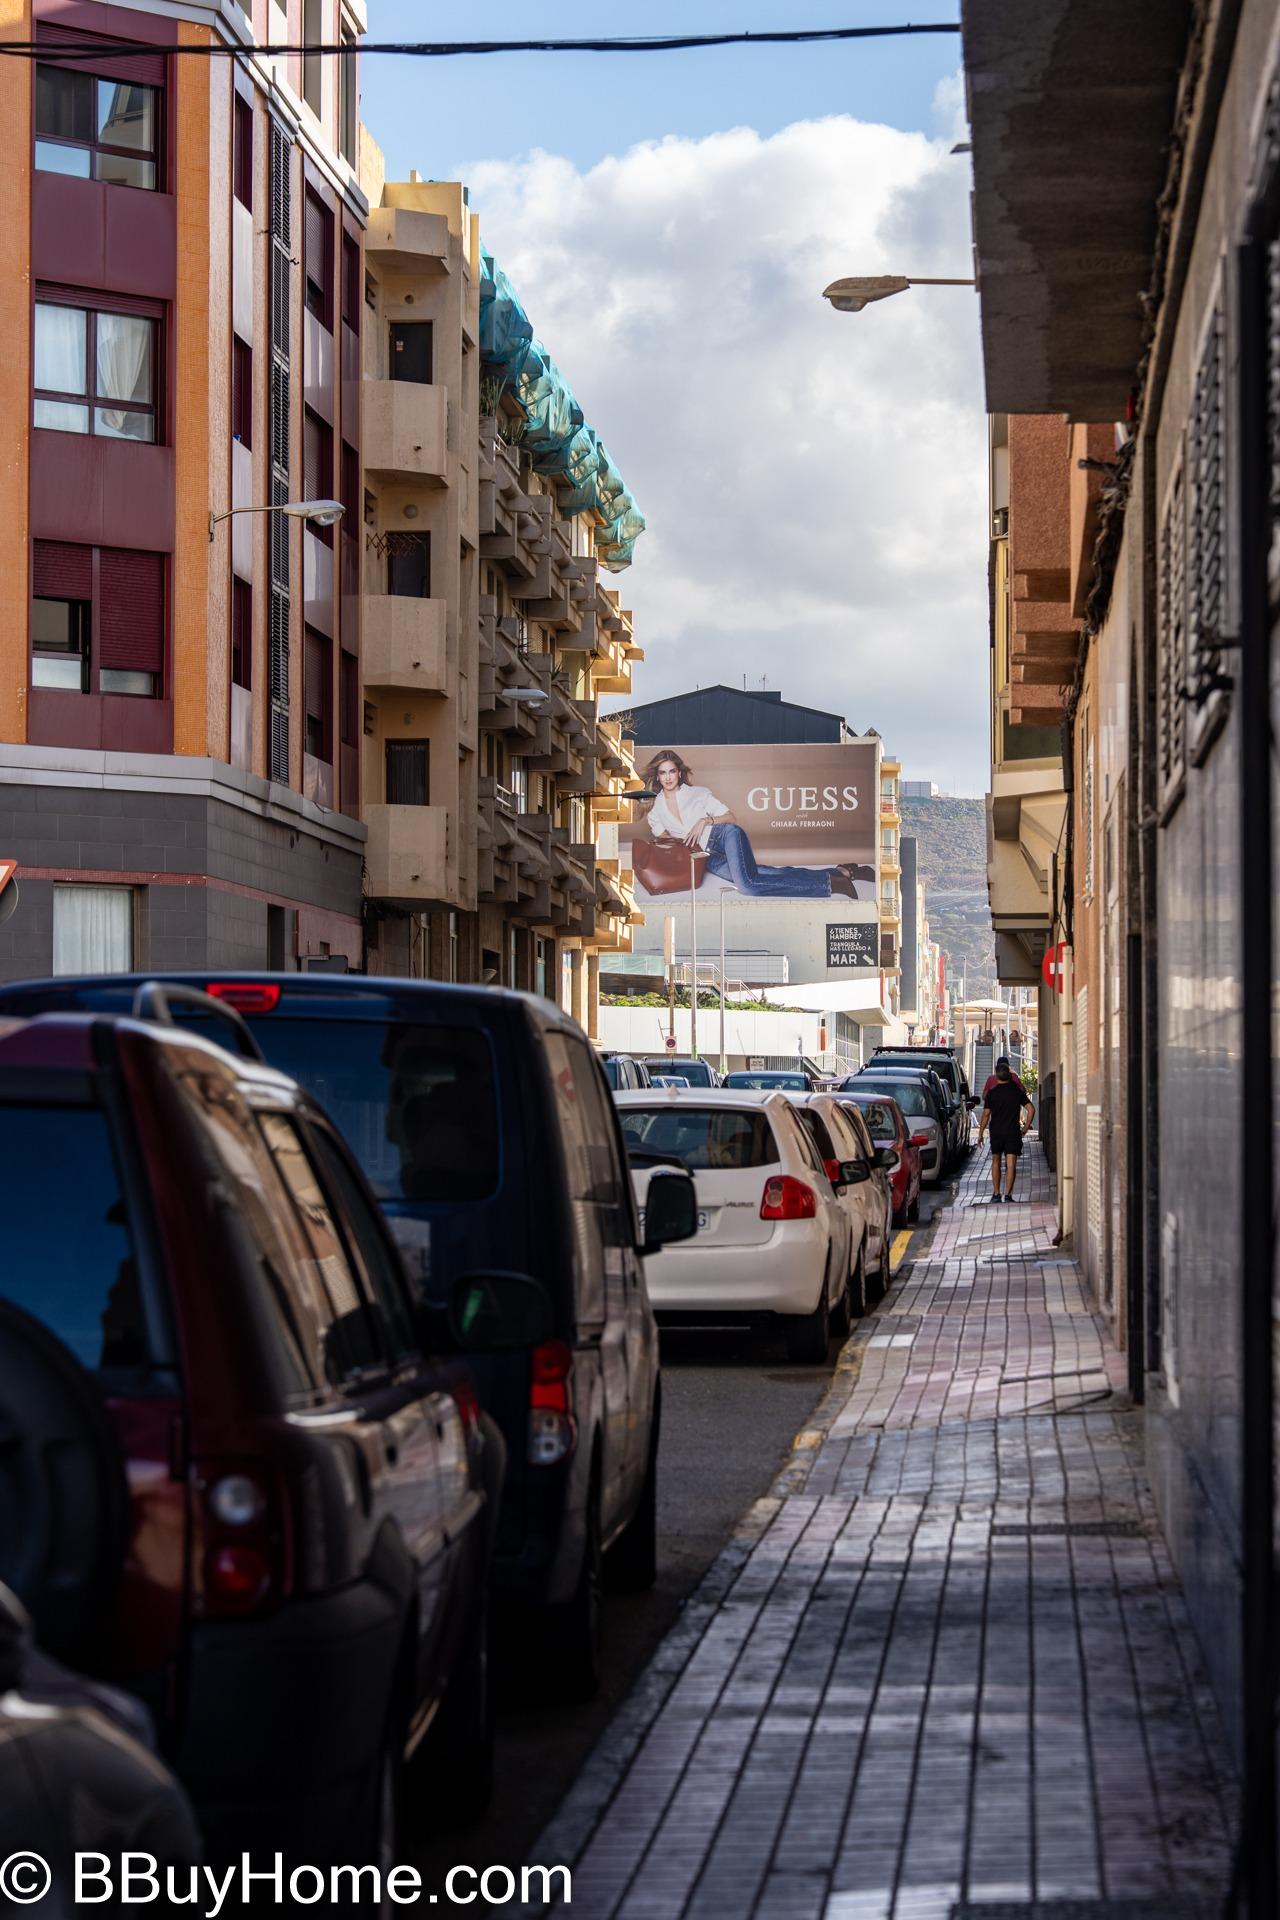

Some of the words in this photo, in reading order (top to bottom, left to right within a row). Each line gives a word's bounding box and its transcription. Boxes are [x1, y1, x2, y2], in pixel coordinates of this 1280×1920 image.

[747, 786, 859, 811] GUESS
[771, 820, 798, 828] CHIARA
[800, 820, 835, 828] FERRAGNI
[830, 954, 857, 964] MAR
